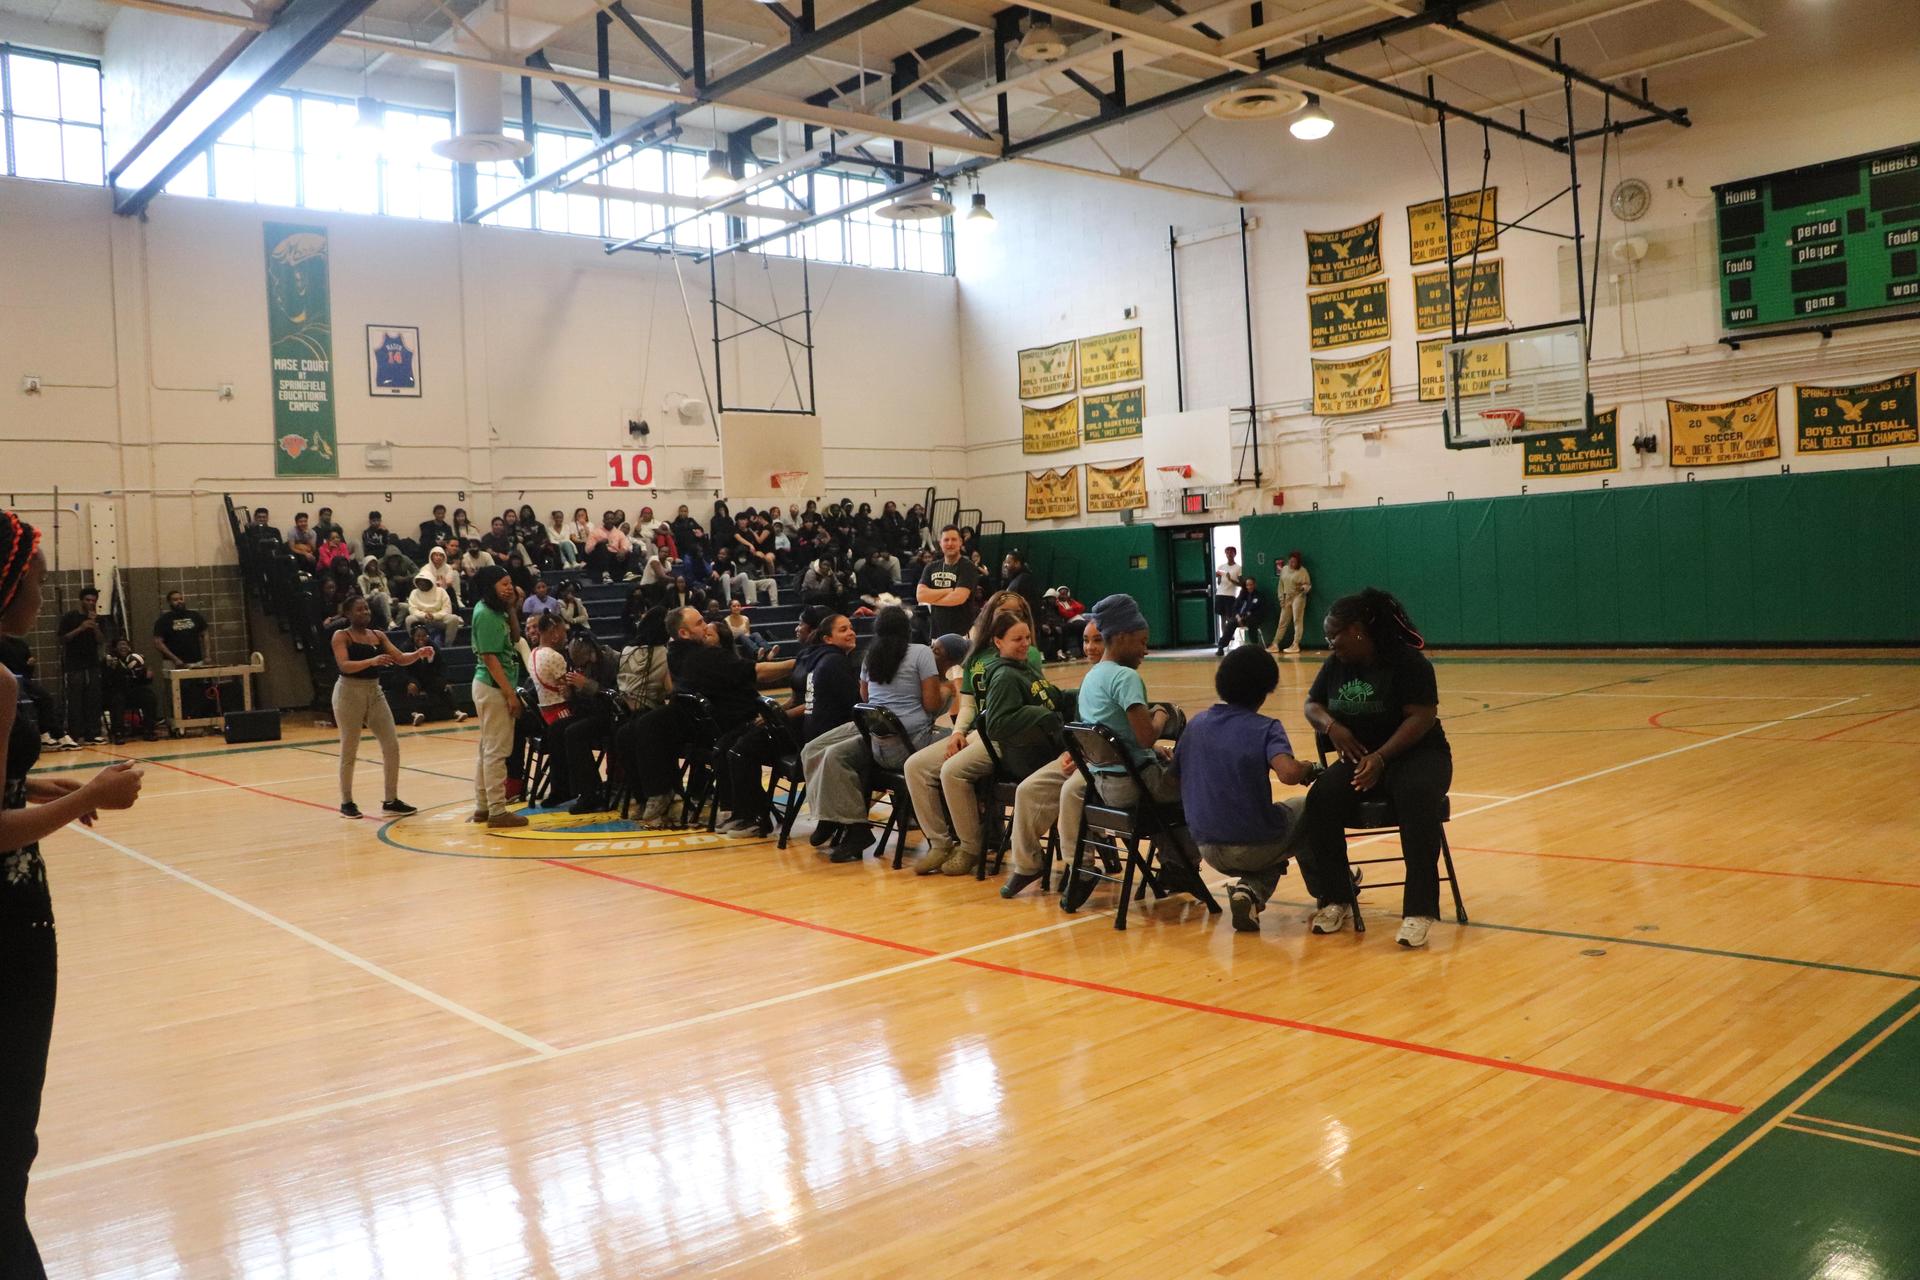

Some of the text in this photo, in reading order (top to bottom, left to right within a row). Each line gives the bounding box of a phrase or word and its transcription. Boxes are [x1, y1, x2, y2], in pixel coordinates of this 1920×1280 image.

[1872, 155, 1919, 175] Guests
[1725, 188, 1757, 205] Home
[1797, 220, 1837, 241] period
[1414, 237, 1435, 249] BOYS
[1888, 229, 1919, 246] fouls
[1798, 244, 1838, 263] player
[1726, 258, 1753, 274] fouls
[1893, 283, 1919, 297] won
[1418, 304, 1442, 316] GIRLS
[1805, 295, 1836, 313] game
[1731, 307, 1753, 321] won
[1312, 317, 1388, 336] GIRLS VOLLEYBALL
[274, 358, 330, 372] MASE COURT
[298, 372, 306, 380] AT
[1422, 376, 1445, 384] GIRLS
[279, 380, 327, 391] SPRINGFIELD
[278, 390, 328, 402] EDUCATIONAL
[1318, 384, 1385, 400] GIRLS VOLLEYBALL
[1800, 388, 1850, 398] SPRINGFIELD
[288, 401, 320, 412] CAMPUS
[1814, 407, 1828, 418] 19
[1688, 413, 1757, 429] 20 02
[1805, 418, 1910, 437] BOYS VOLLEYBALL
[1704, 432, 1744, 443] SOCCER
[1800, 429, 1917, 450] PSAL QUEENS III CHAMPIONS
[1528, 448, 1613, 462] GIRLS VOLLEYBALL
[1674, 445, 1687, 456] PSAL
[1692, 444, 1712, 456] QUEENS
[1528, 464, 1544, 473] PSAL
[1560, 458, 1613, 471] QUARTERFINALIST
[1685, 456, 1700, 464] CITY
[609, 454, 652, 488] 10
[1781, 464, 1790, 474] H
[1686, 472, 1696, 482] G
[302, 492, 314, 504] 10
[384, 492, 392, 502] 9
[458, 490, 465, 502] 8
[518, 490, 525, 500] 7
[587, 490, 594, 500] 6
[651, 489, 658, 499] 5
[713, 489, 719, 498] 4
[1448, 491, 1454, 501] D
